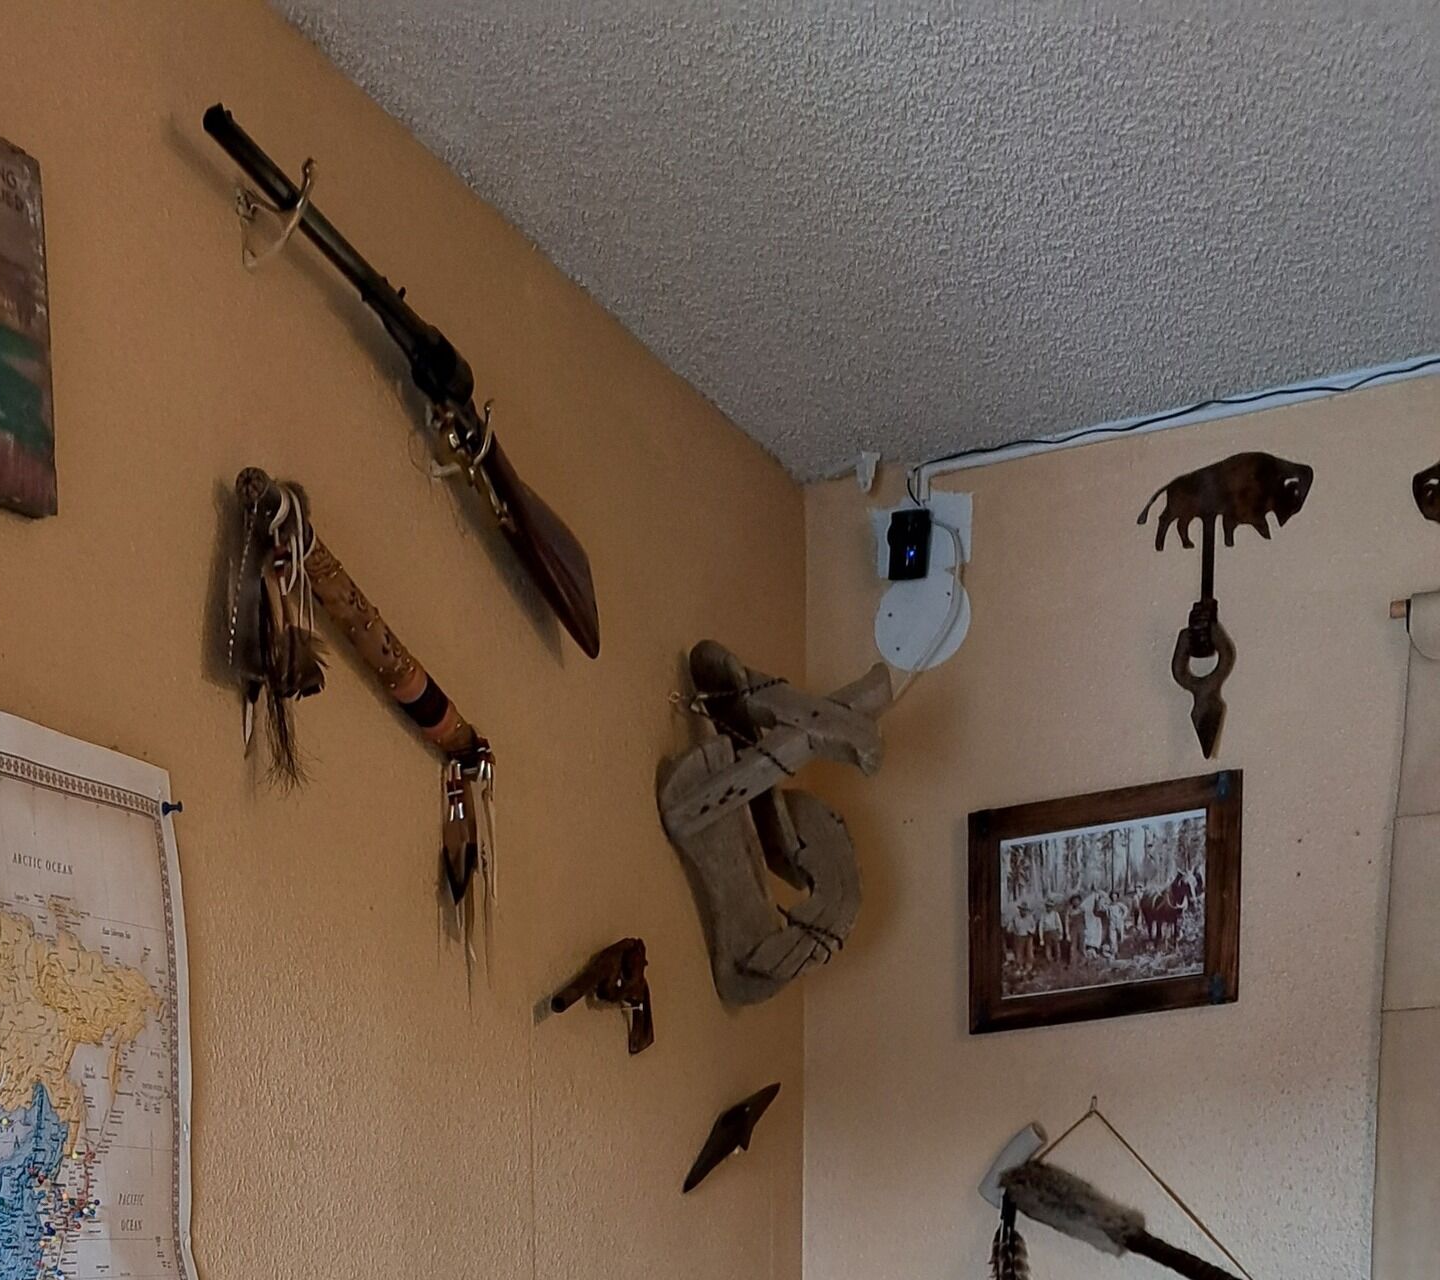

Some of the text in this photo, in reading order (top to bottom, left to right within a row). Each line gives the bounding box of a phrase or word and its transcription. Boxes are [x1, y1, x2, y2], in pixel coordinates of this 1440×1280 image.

[12, 852, 74, 876] ARCTIC OCEAN
[120, 1218, 143, 1233] OCEAN
